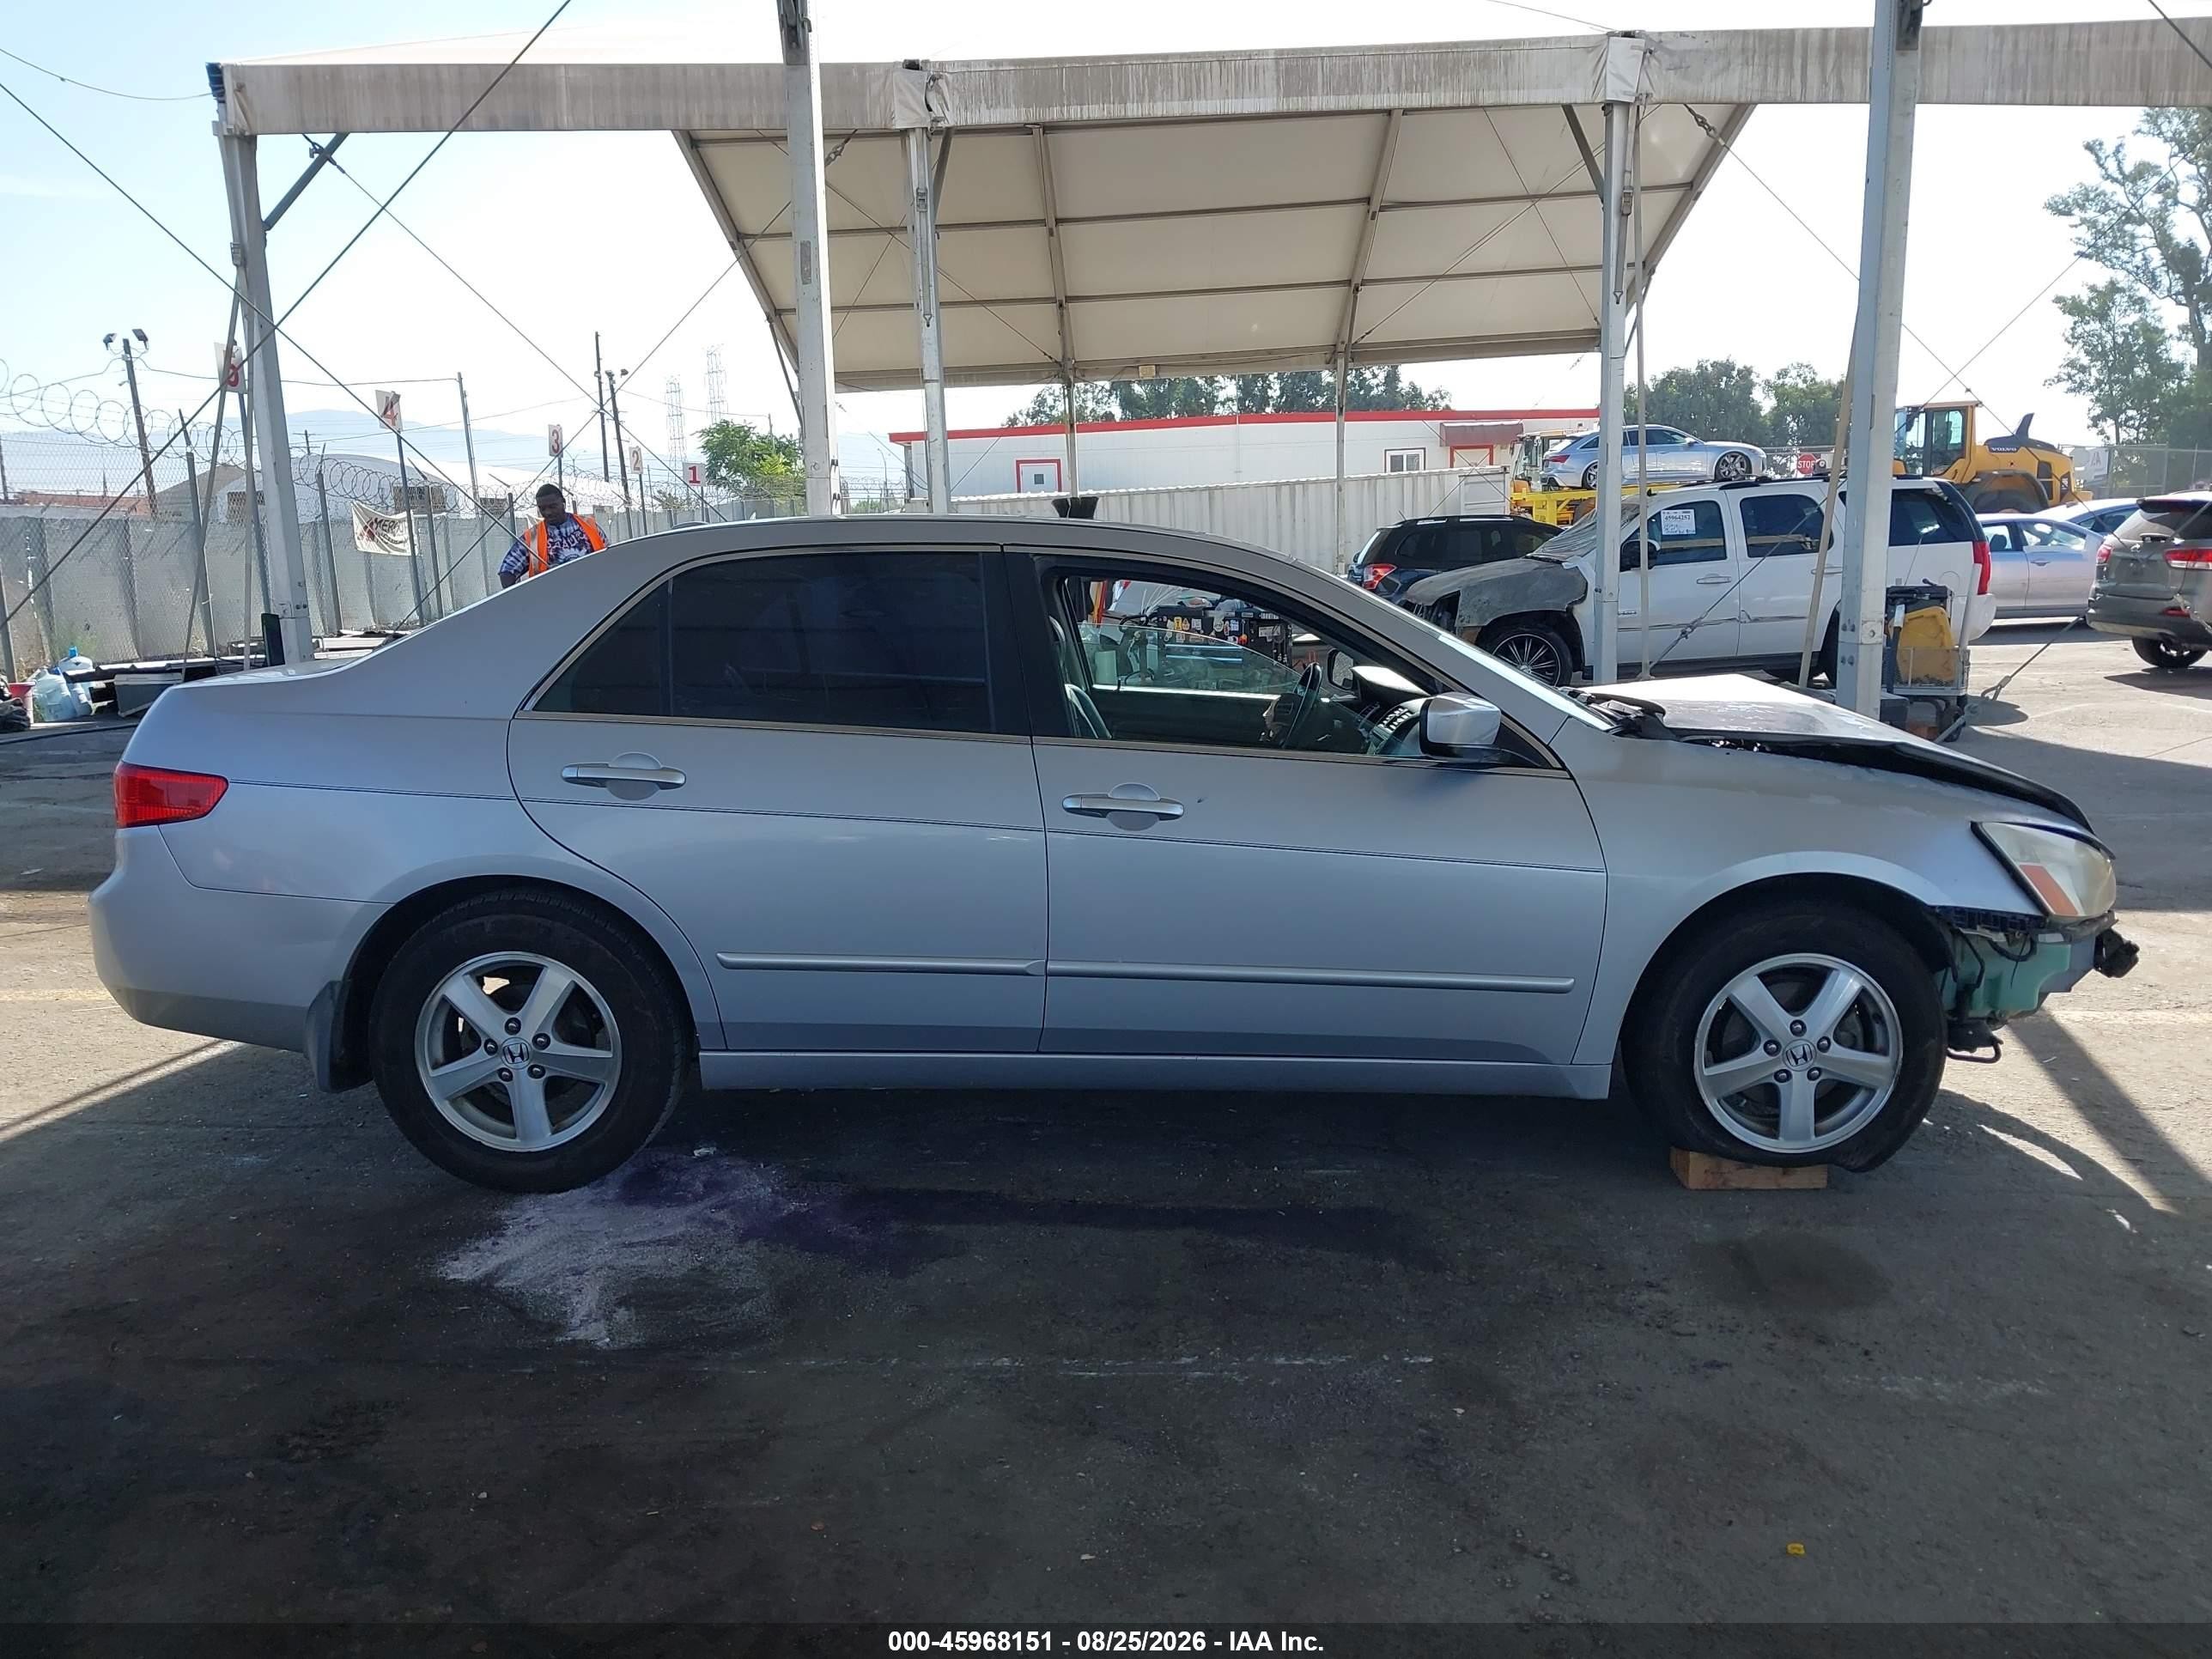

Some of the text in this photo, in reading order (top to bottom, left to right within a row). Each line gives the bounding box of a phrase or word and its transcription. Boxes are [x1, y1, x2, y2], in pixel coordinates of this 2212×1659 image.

[383, 396, 396, 427] 4
[551, 429, 560, 454] 3
[632, 450, 641, 471] 2
[688, 465, 702, 484] 1
